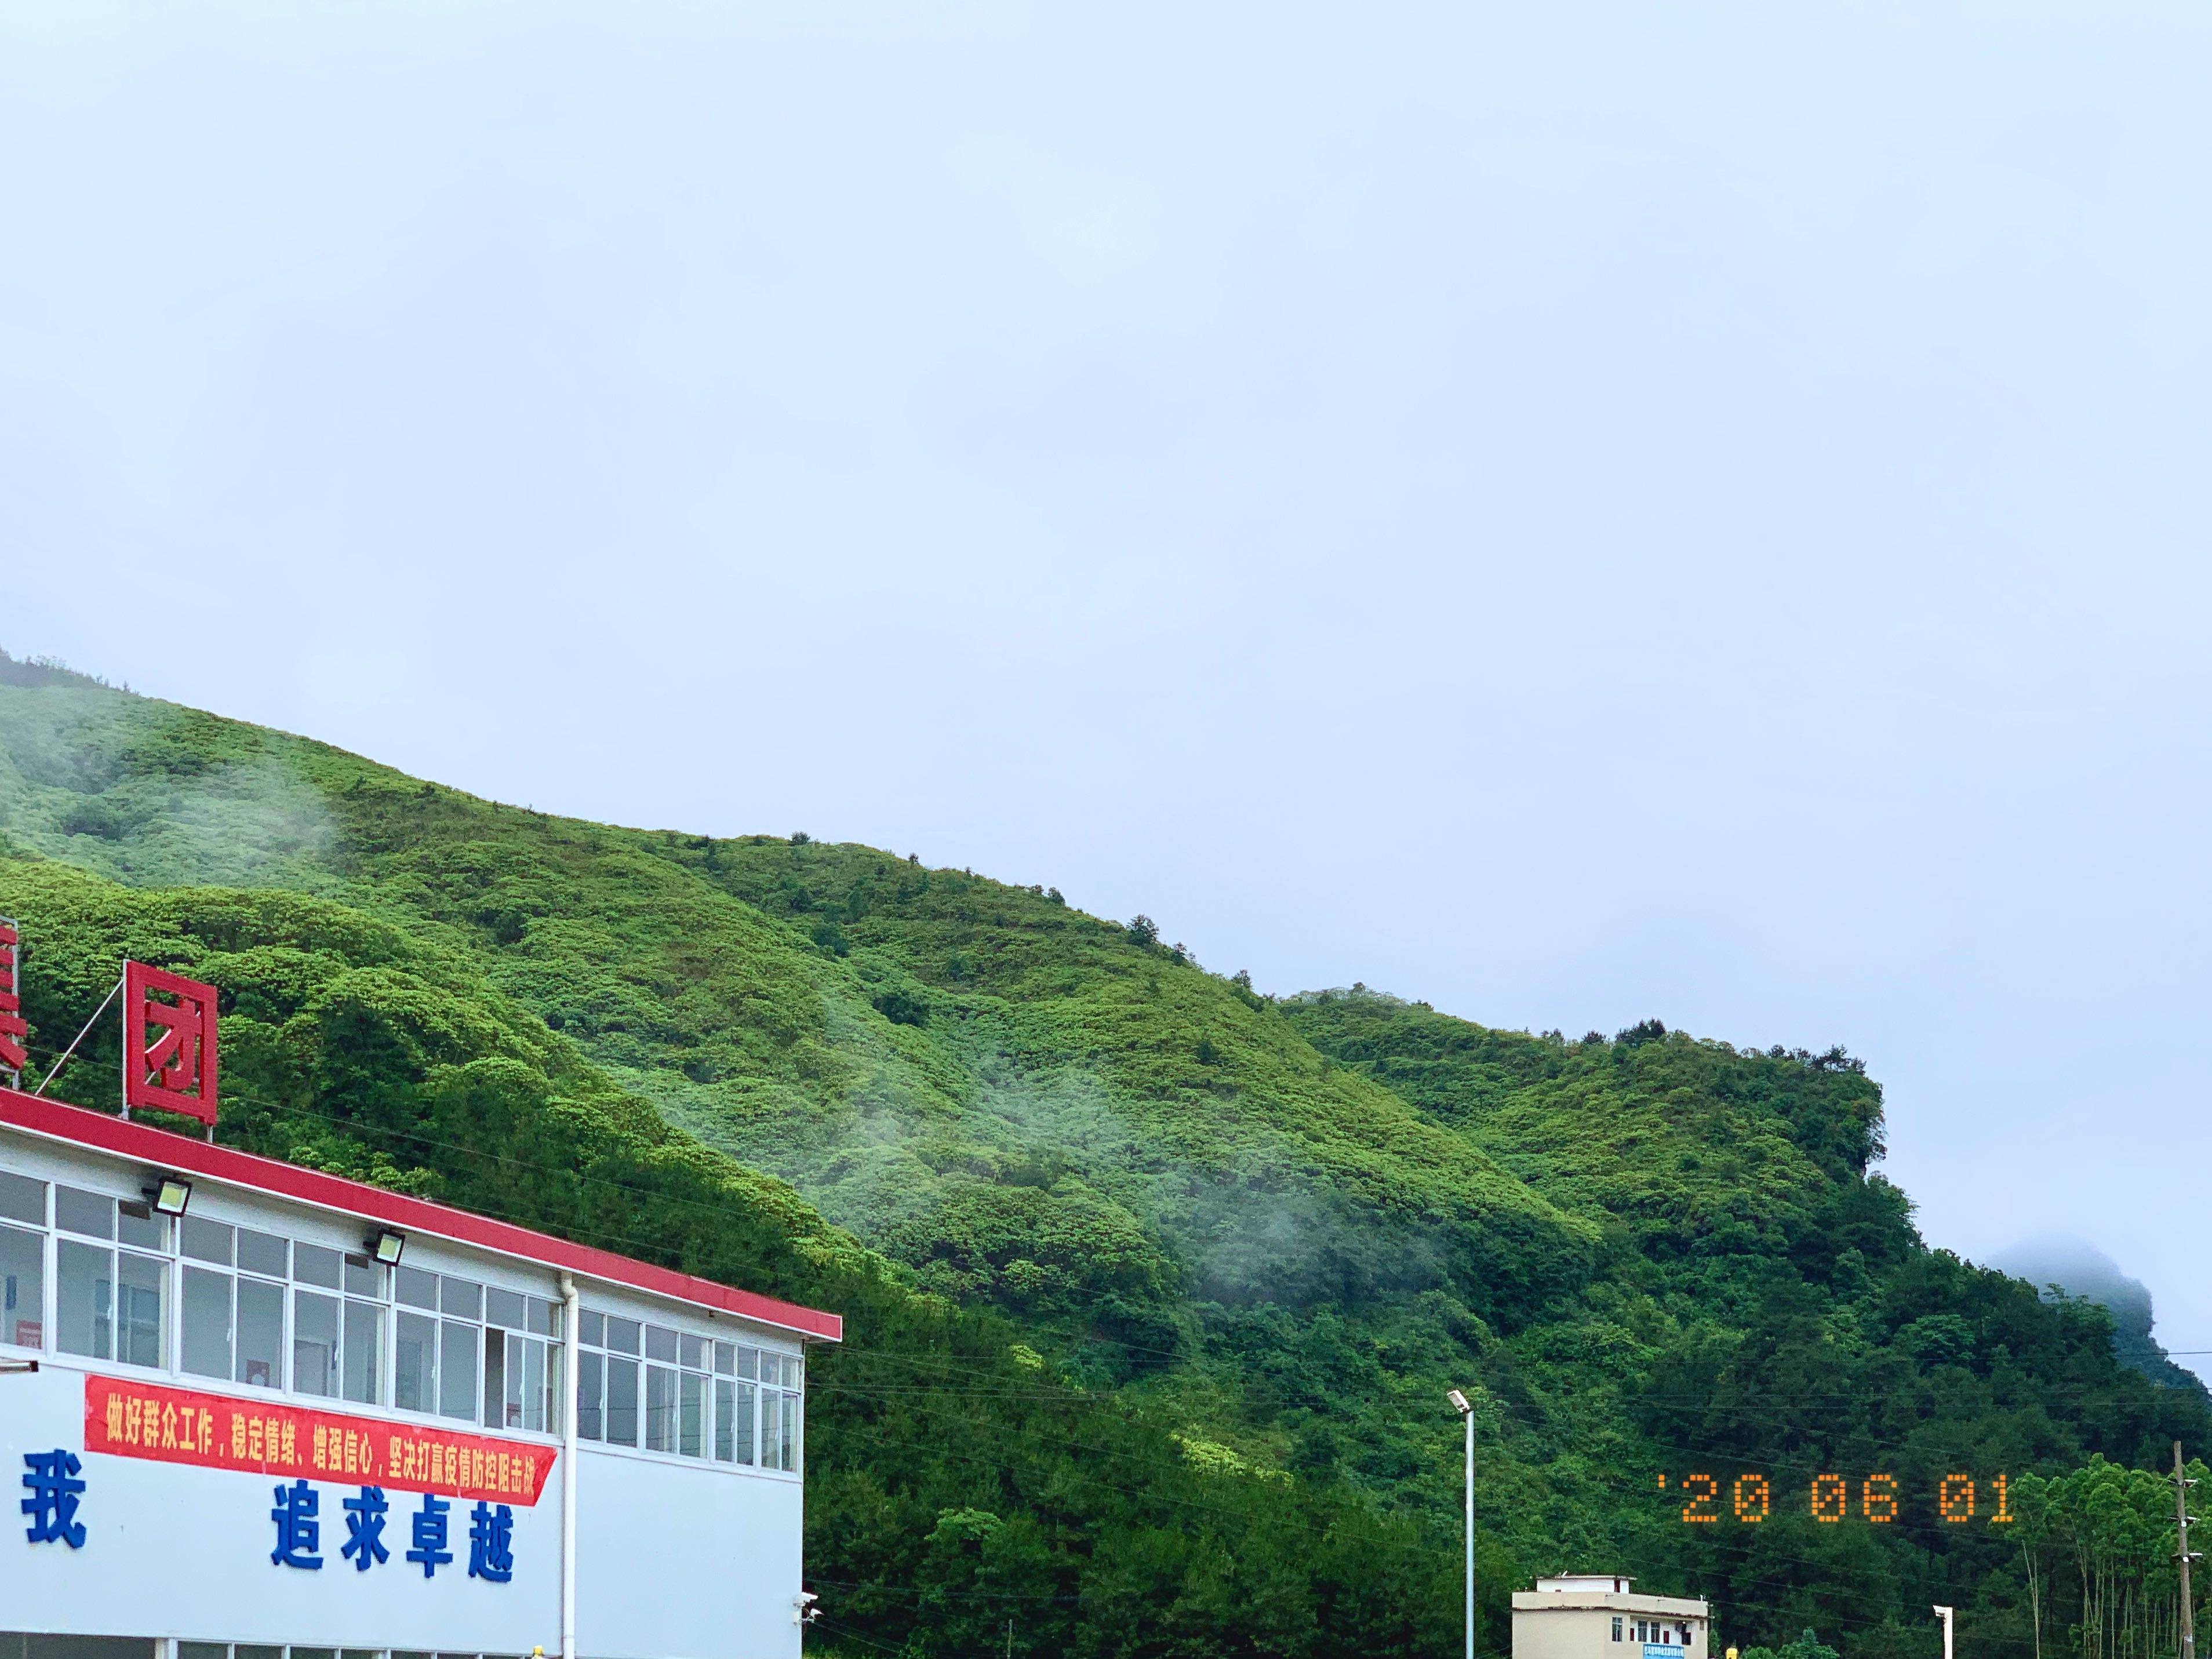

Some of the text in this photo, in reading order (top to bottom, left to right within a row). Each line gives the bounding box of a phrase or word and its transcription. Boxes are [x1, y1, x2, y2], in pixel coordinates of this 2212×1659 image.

[21, 1449, 514, 1582] 我 追求卓越
